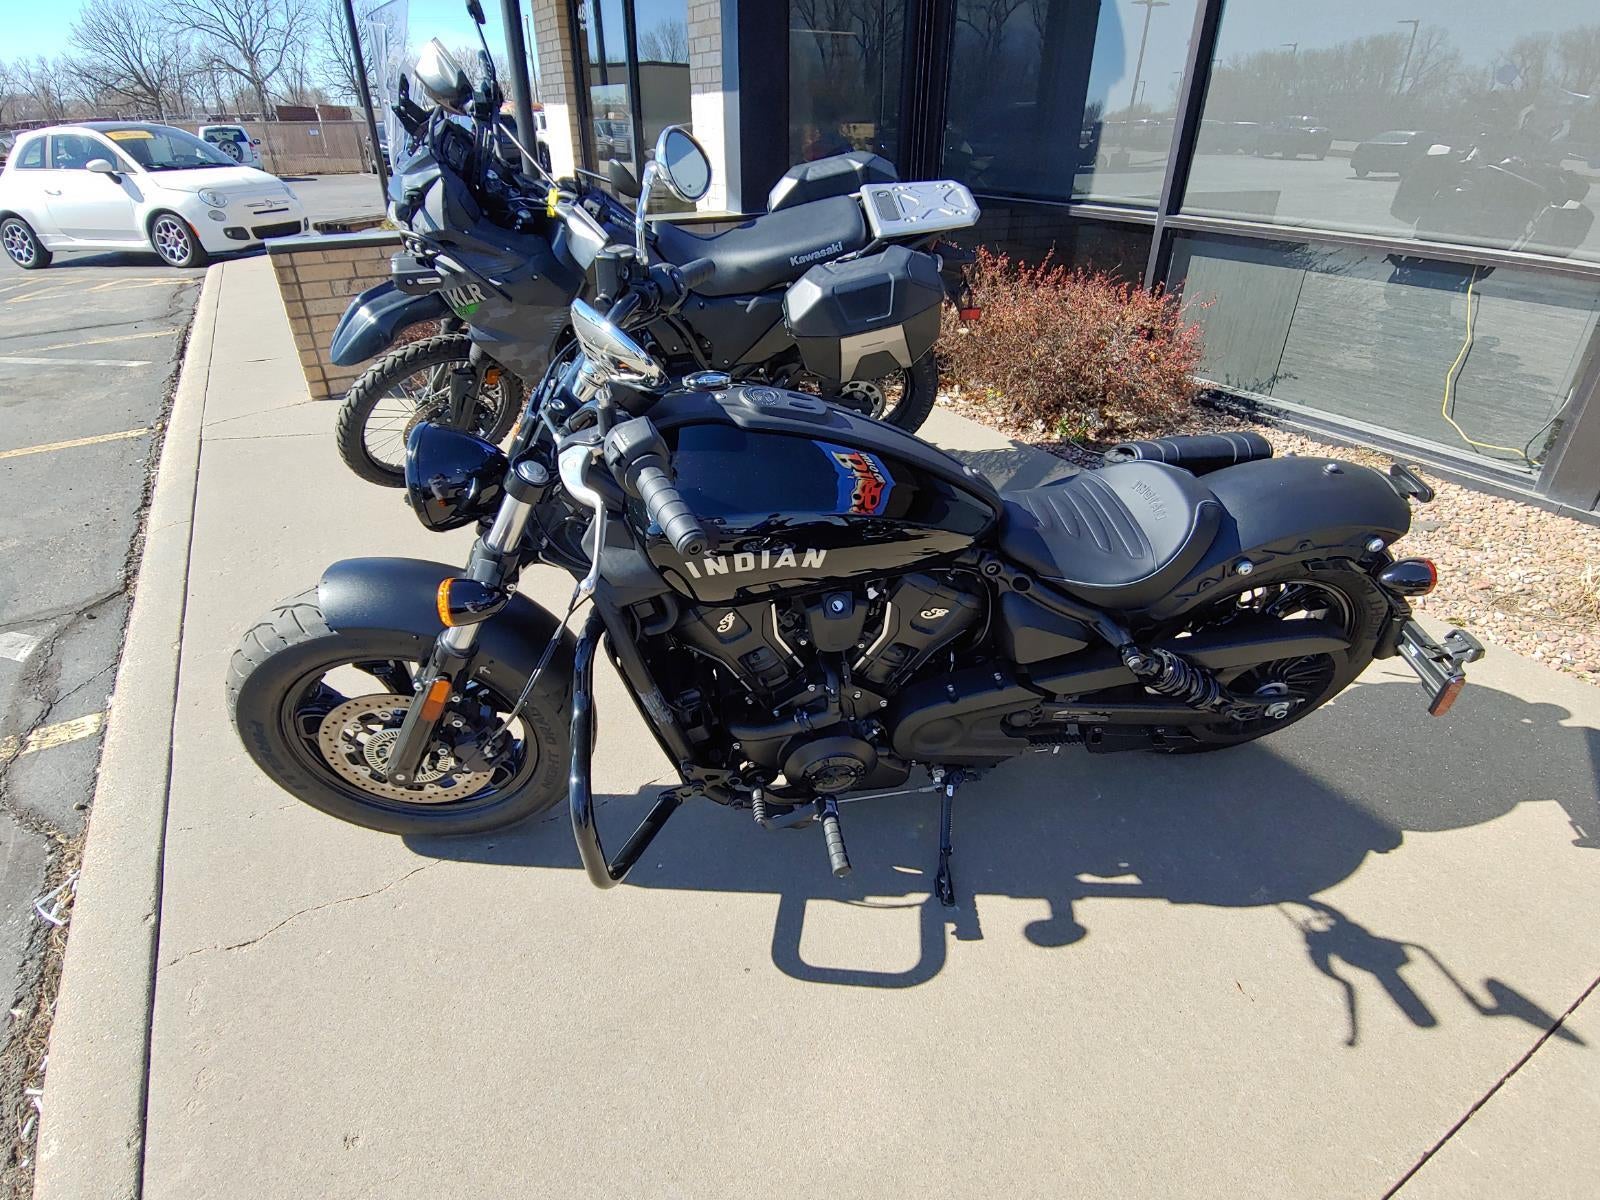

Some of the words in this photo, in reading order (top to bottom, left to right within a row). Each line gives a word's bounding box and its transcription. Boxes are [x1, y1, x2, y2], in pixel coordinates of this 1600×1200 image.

[789, 241, 843, 267] Kawasaki
[446, 283, 487, 308] KLR
[685, 548, 827, 579] INDIAN
